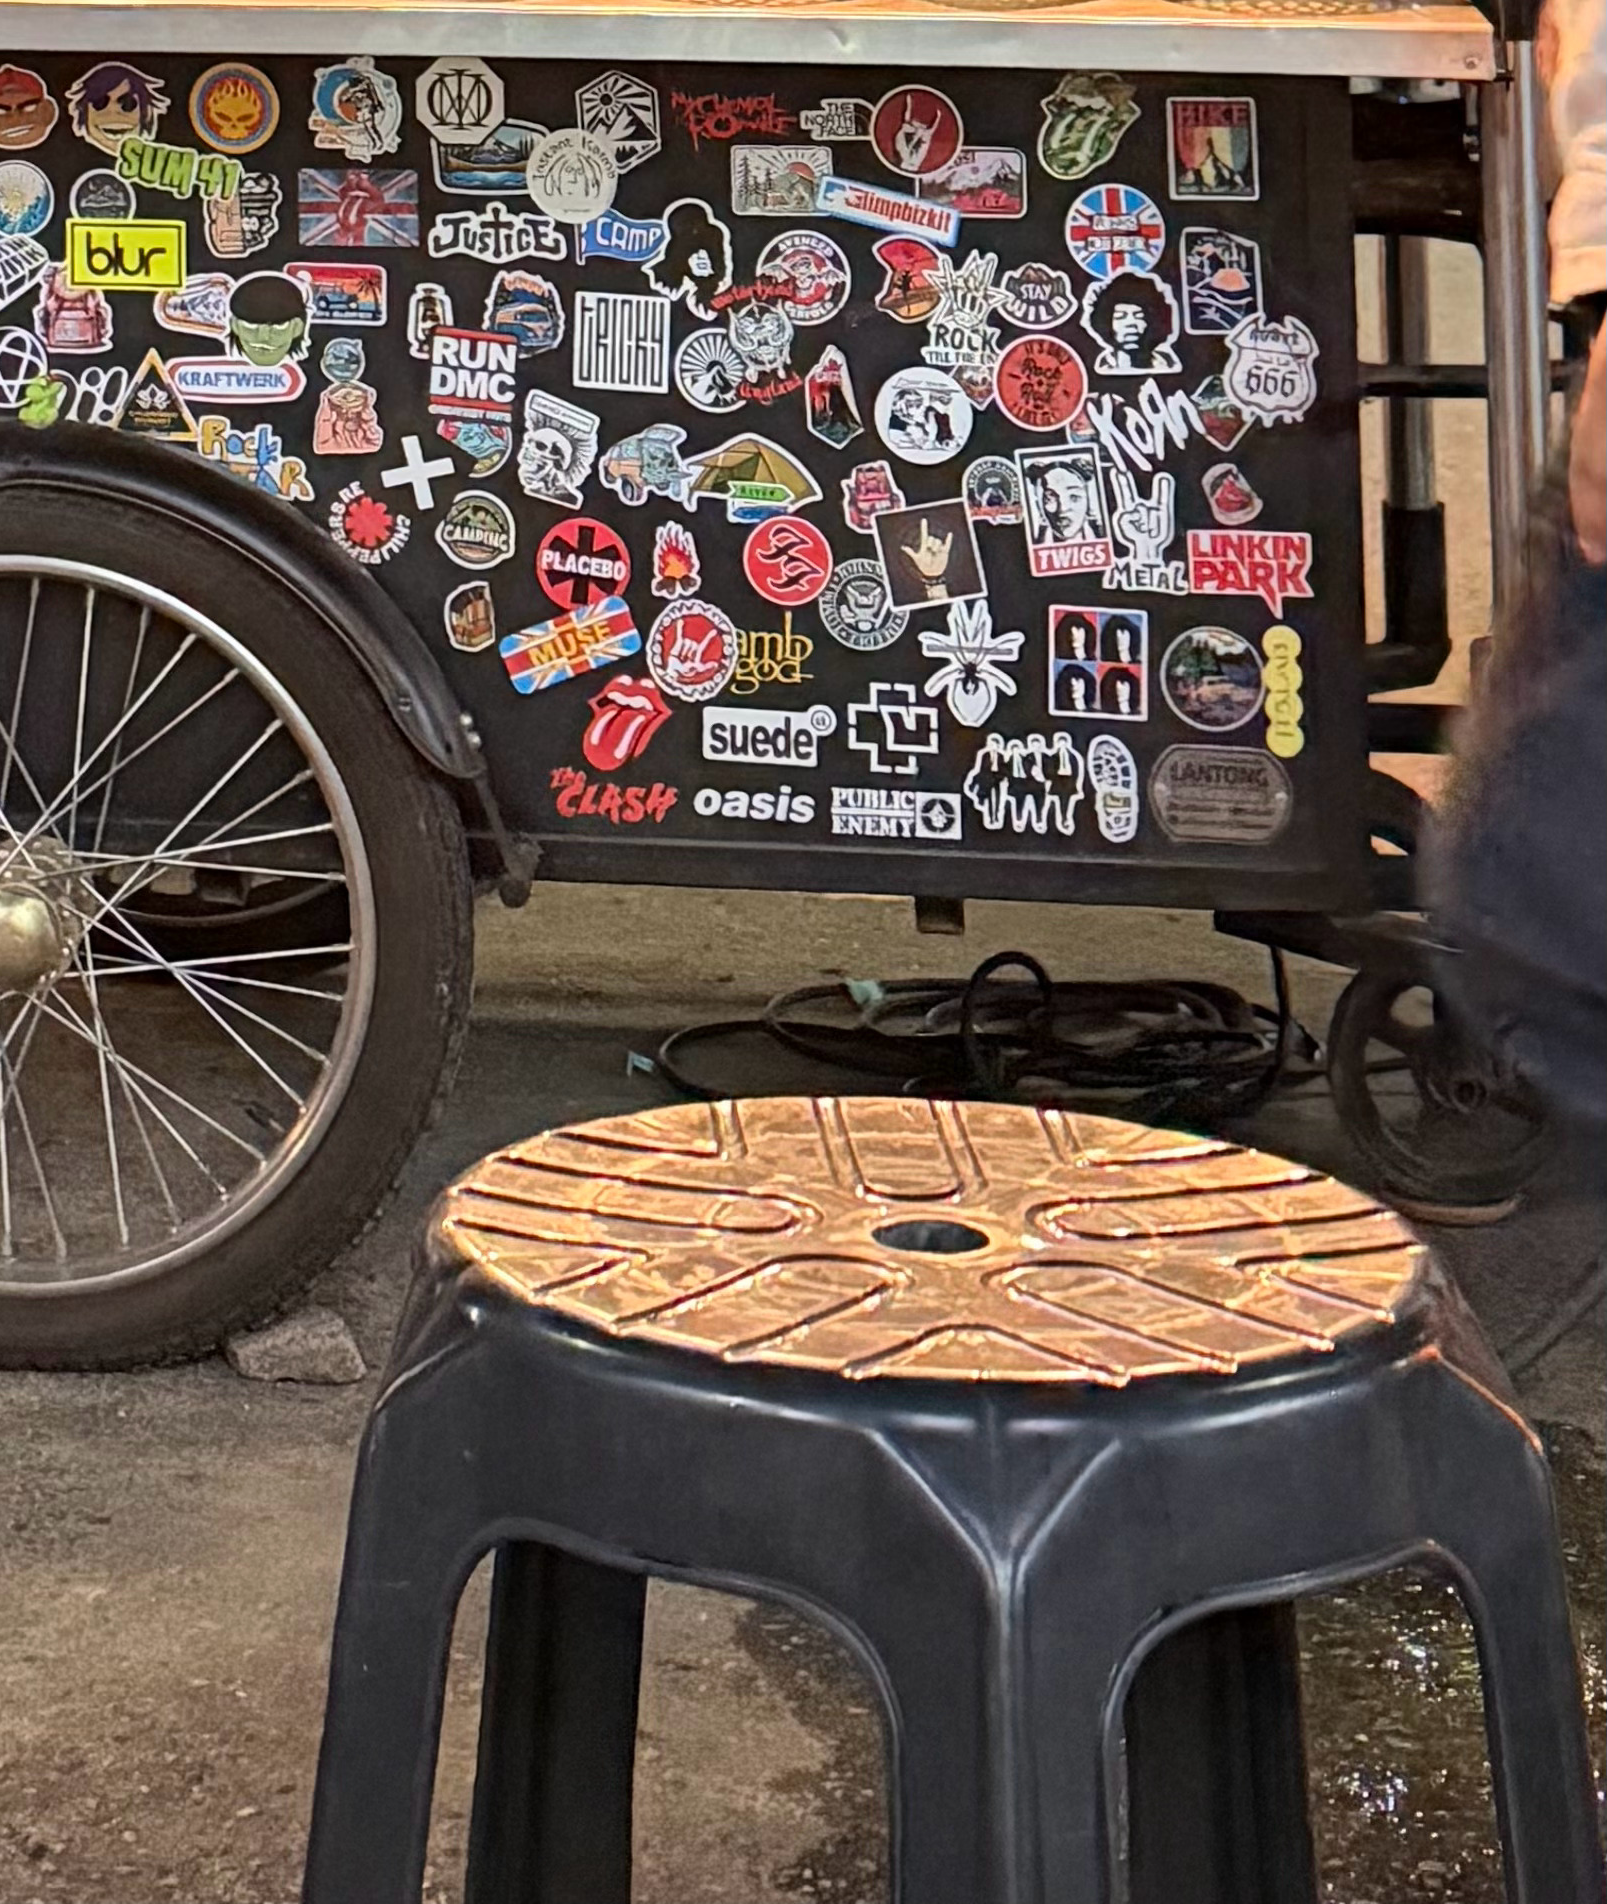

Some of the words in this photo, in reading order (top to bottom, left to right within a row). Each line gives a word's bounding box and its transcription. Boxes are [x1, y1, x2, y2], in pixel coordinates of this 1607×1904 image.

[1177, 103, 1248, 126] HIKE
[120, 139, 194, 197] SUM
[199, 155, 240, 199] 41
[596, 218, 662, 251] CAMP
[86, 231, 166, 277] blur
[1020, 284, 1052, 301] STAY
[1006, 296, 1069, 322] WILD
[935, 323, 995, 352] ROCK
[432, 335, 518, 373] RUN
[178, 372, 286, 388] KRAFTWERK
[430, 366, 516, 403] DMC
[1246, 365, 1299, 398] 666
[444, 523, 508, 549] CAMPING
[1192, 533, 1307, 560] LINKIN
[542, 549, 627, 581] PLACEBO
[1038, 544, 1107, 570] TWIGS
[1108, 562, 1188, 591] METAL
[1192, 559, 1308, 593] PARK
[527, 620, 613, 667] MUSE
[709, 716, 814, 760] suede
[555, 781, 679, 825] CLASH
[694, 784, 816, 823] oasis
[831, 786, 915, 812] PUBLIC
[831, 813, 915, 839] ENEMY
